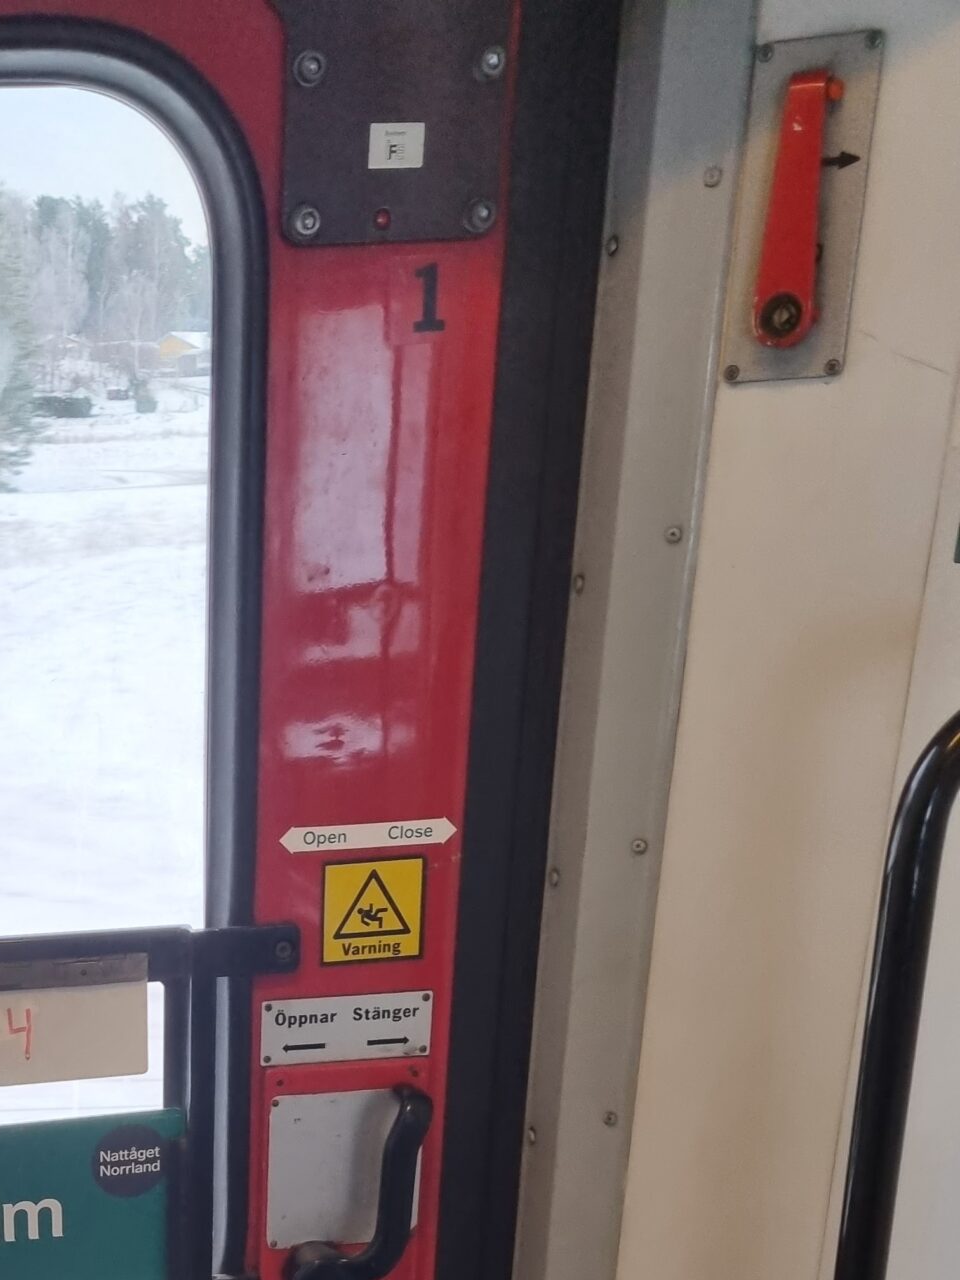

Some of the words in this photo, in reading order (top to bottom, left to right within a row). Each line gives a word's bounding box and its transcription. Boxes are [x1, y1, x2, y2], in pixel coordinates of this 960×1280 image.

[413, 262, 445, 333] 1
[303, 831, 347, 847] Open
[388, 825, 433, 840] Close
[342, 941, 401, 956] Varning
[275, 1010, 337, 1028] Öppnar
[353, 1006, 420, 1024] Stänger
[99, 1146, 161, 1163] Nattåget
[99, 1160, 161, 1177] Norrland
